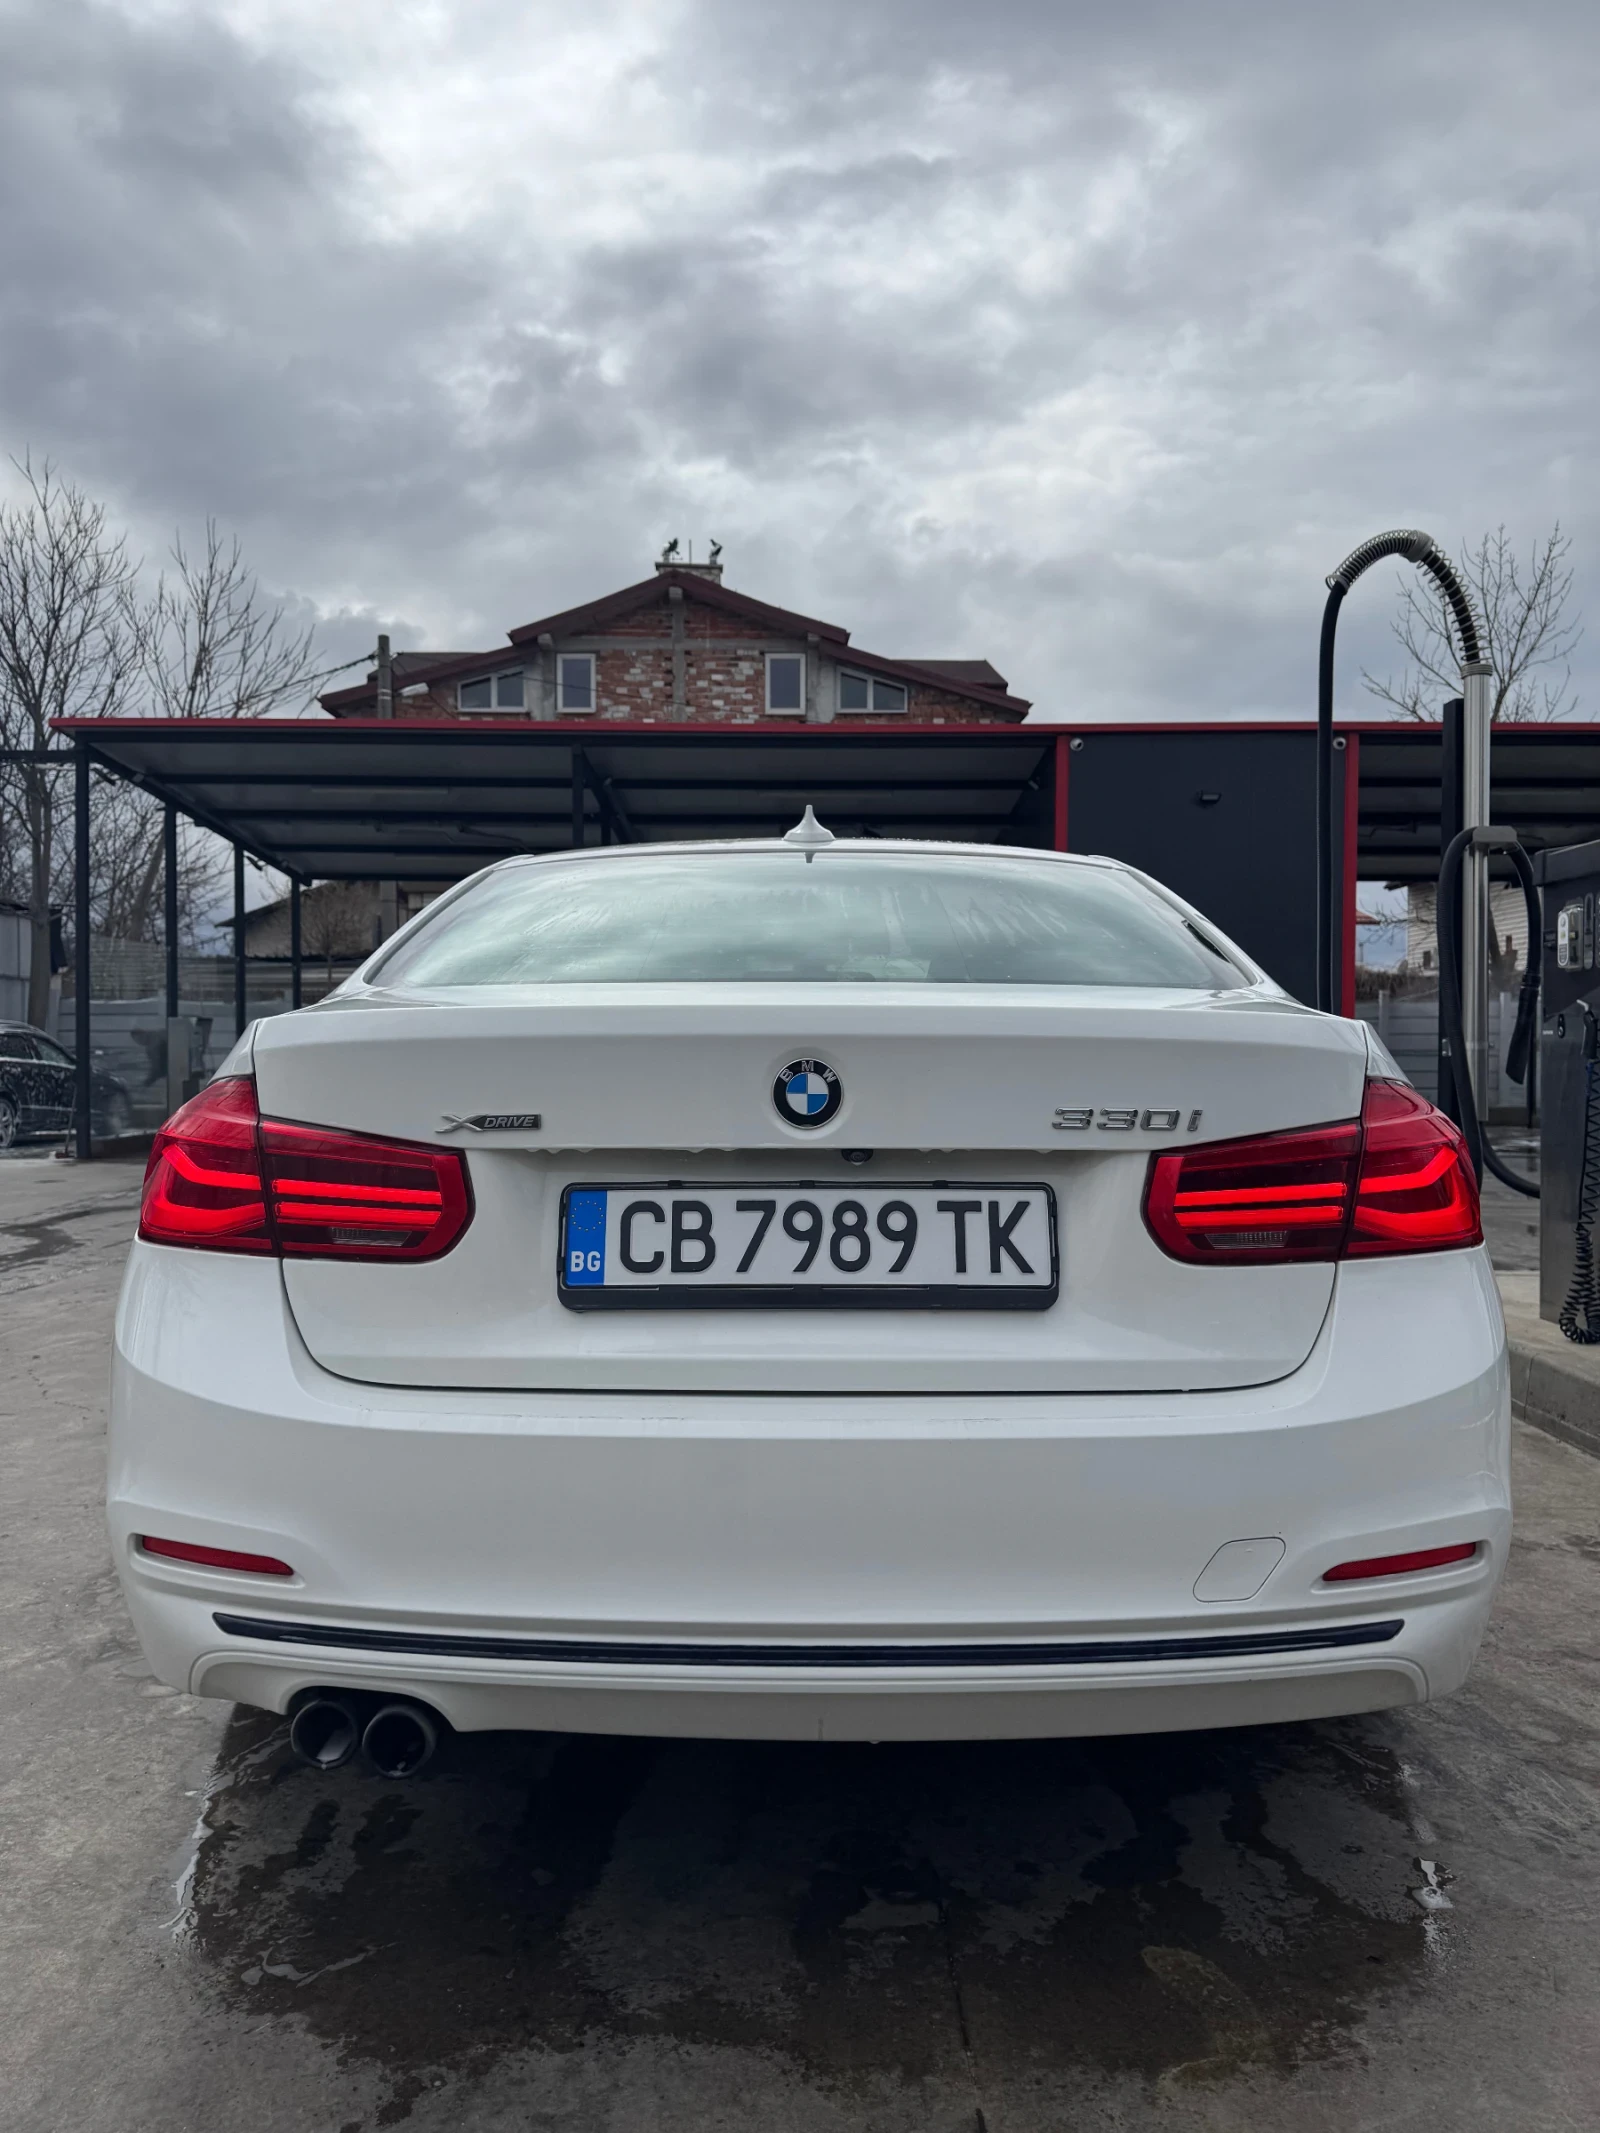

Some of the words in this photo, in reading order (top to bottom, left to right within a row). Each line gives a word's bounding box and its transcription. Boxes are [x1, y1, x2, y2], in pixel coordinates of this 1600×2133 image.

[780, 1060, 837, 1083] BMW
[1052, 1107, 1203, 1132] 330i
[620, 1200, 716, 1273] CB
[736, 1200, 918, 1273] 7989
[936, 1200, 1035, 1274] TK
[570, 1250, 601, 1272] BG
